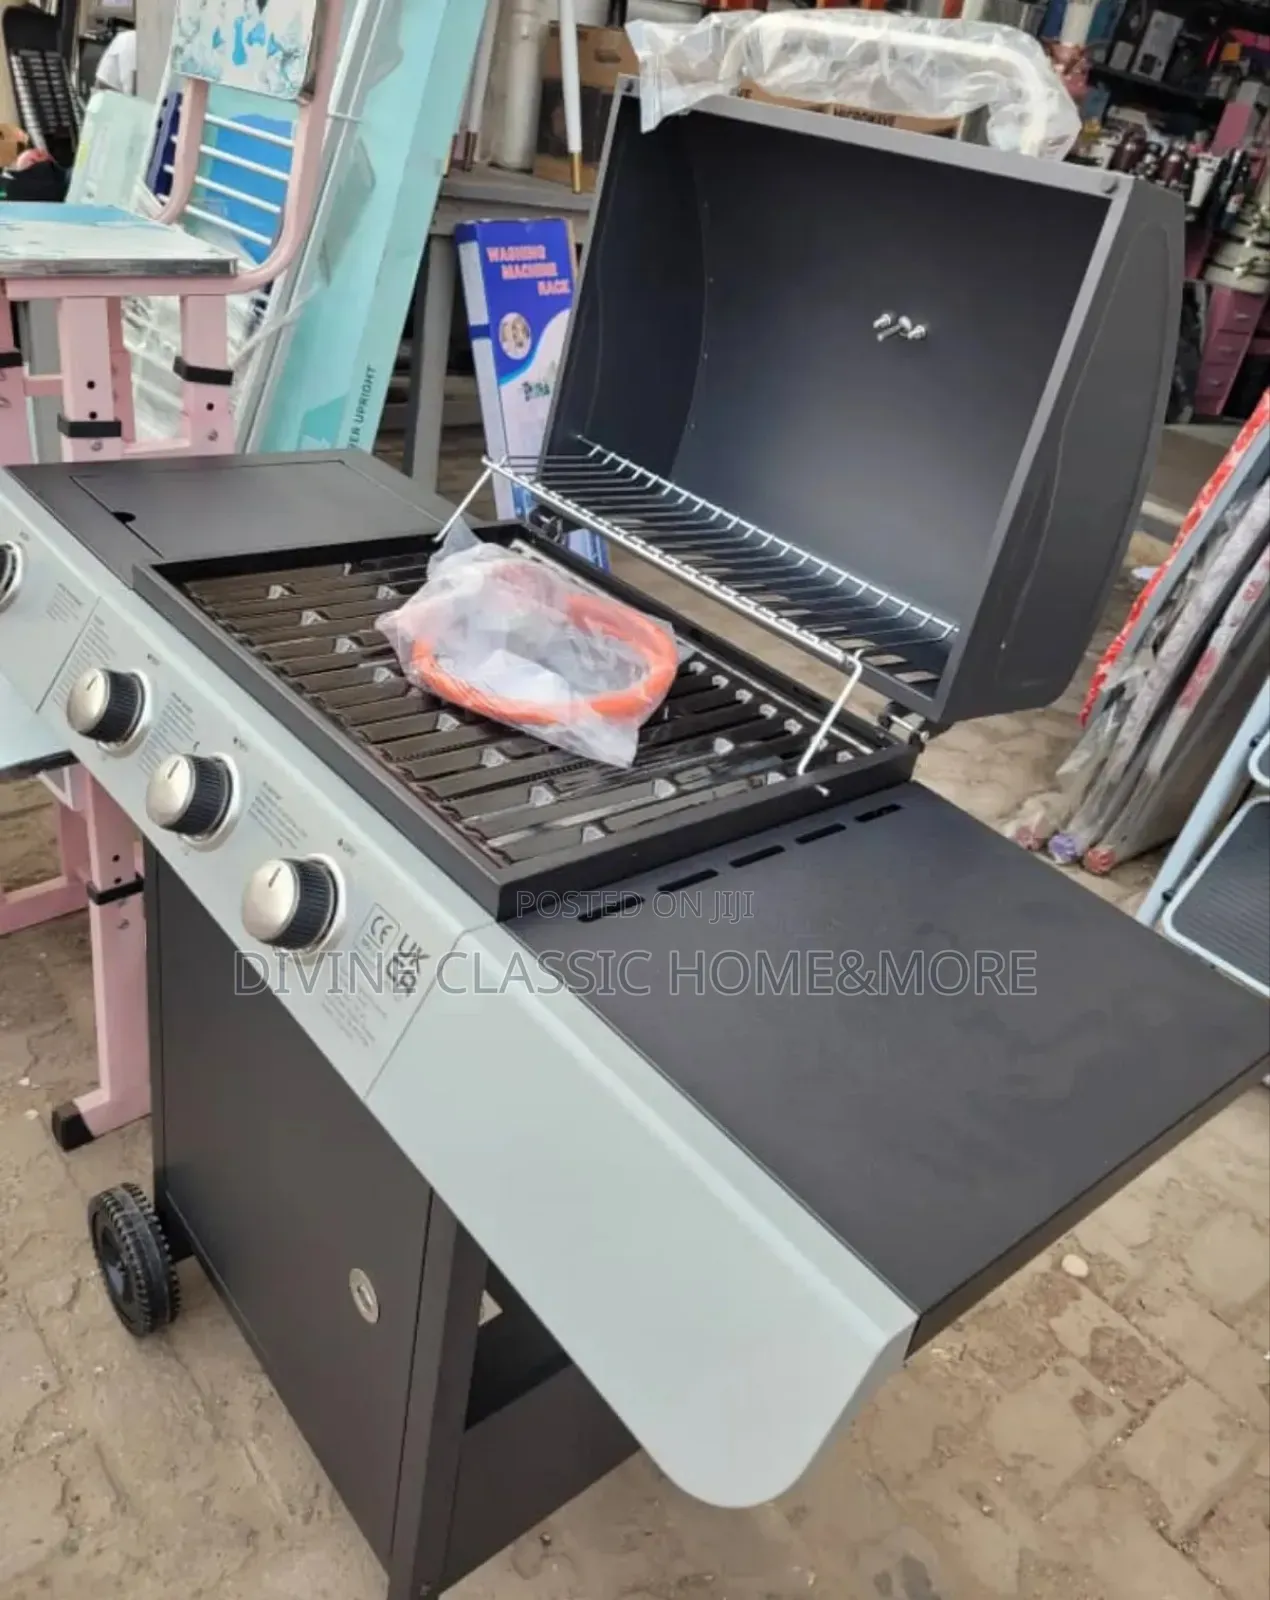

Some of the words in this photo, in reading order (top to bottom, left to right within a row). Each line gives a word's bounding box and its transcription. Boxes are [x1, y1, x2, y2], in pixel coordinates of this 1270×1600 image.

[486, 244, 547, 263] WASHING
[501, 262, 558, 280] MACHINE
[537, 279, 571, 296] RACK
[353, 364, 377, 424] UPRIGHT
